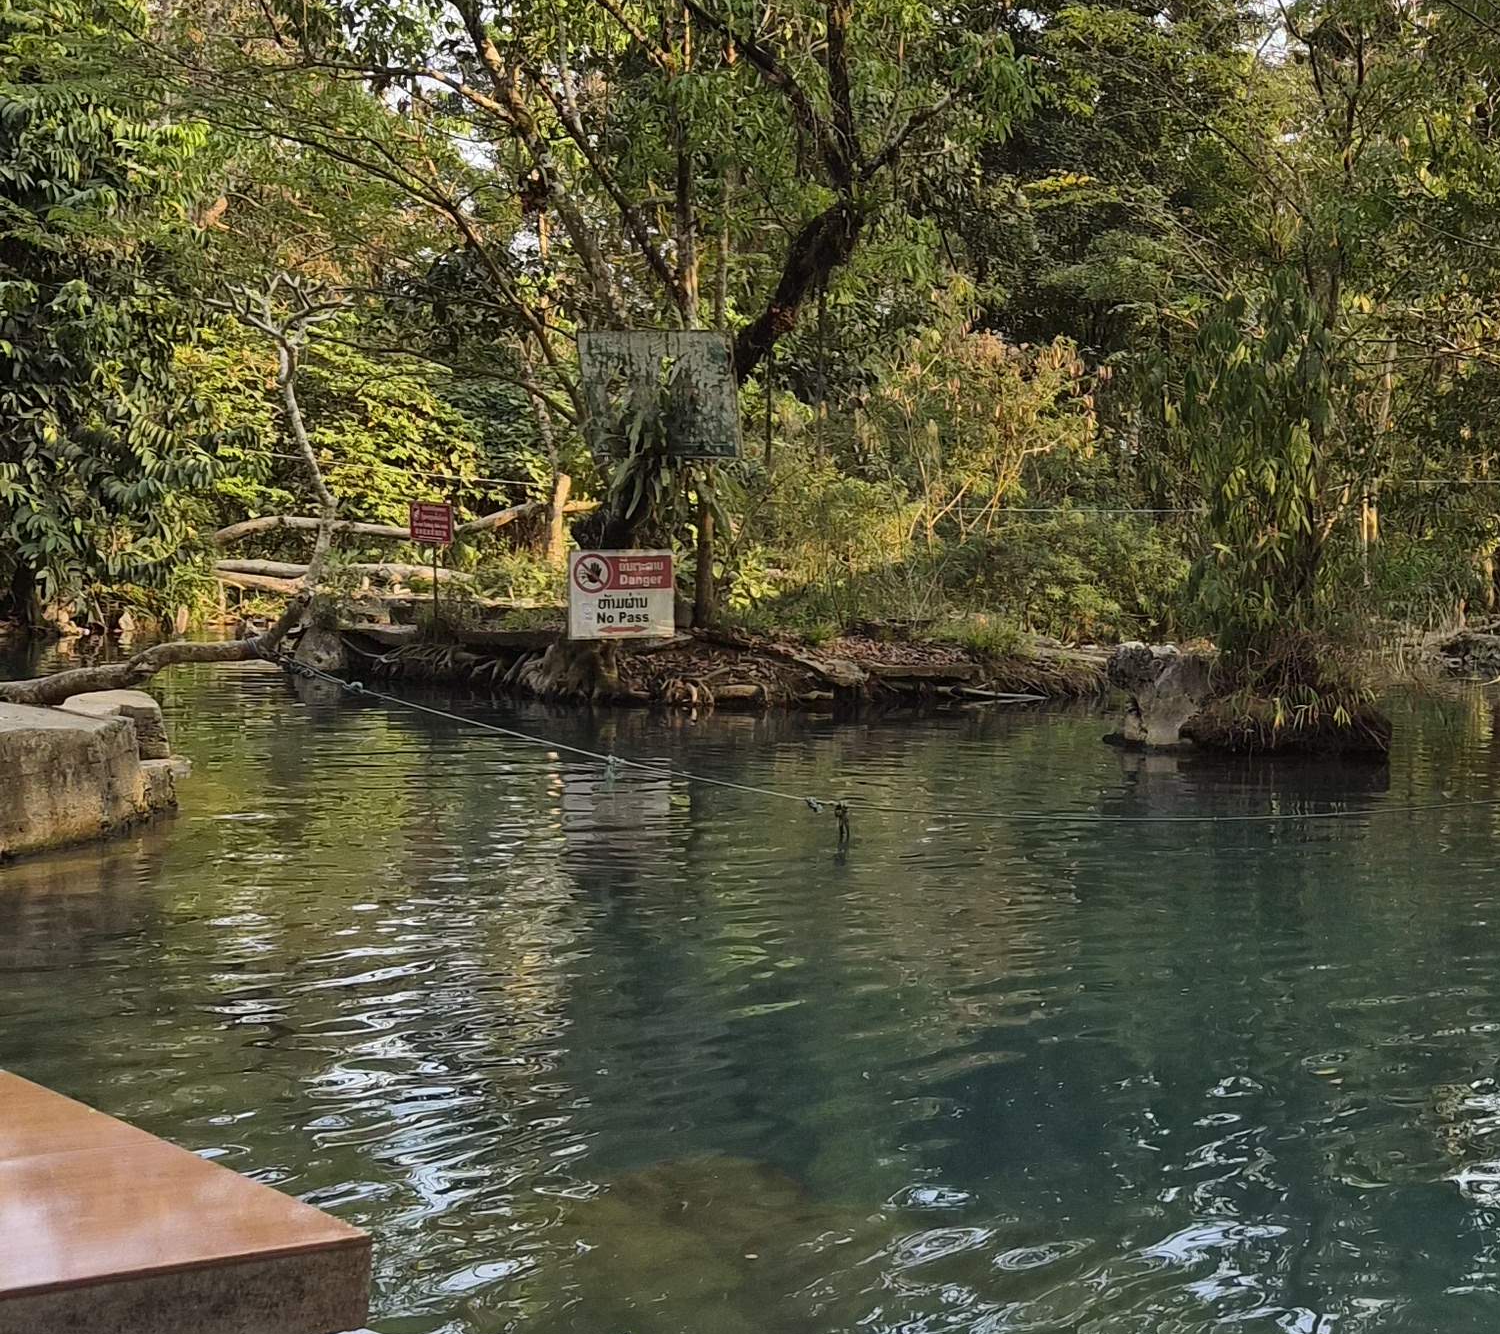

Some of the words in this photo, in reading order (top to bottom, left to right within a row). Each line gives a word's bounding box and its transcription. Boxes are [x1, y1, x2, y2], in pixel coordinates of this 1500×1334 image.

[619, 575, 663, 587] Danger
[596, 612, 615, 624] No
[618, 612, 650, 623] Pass
